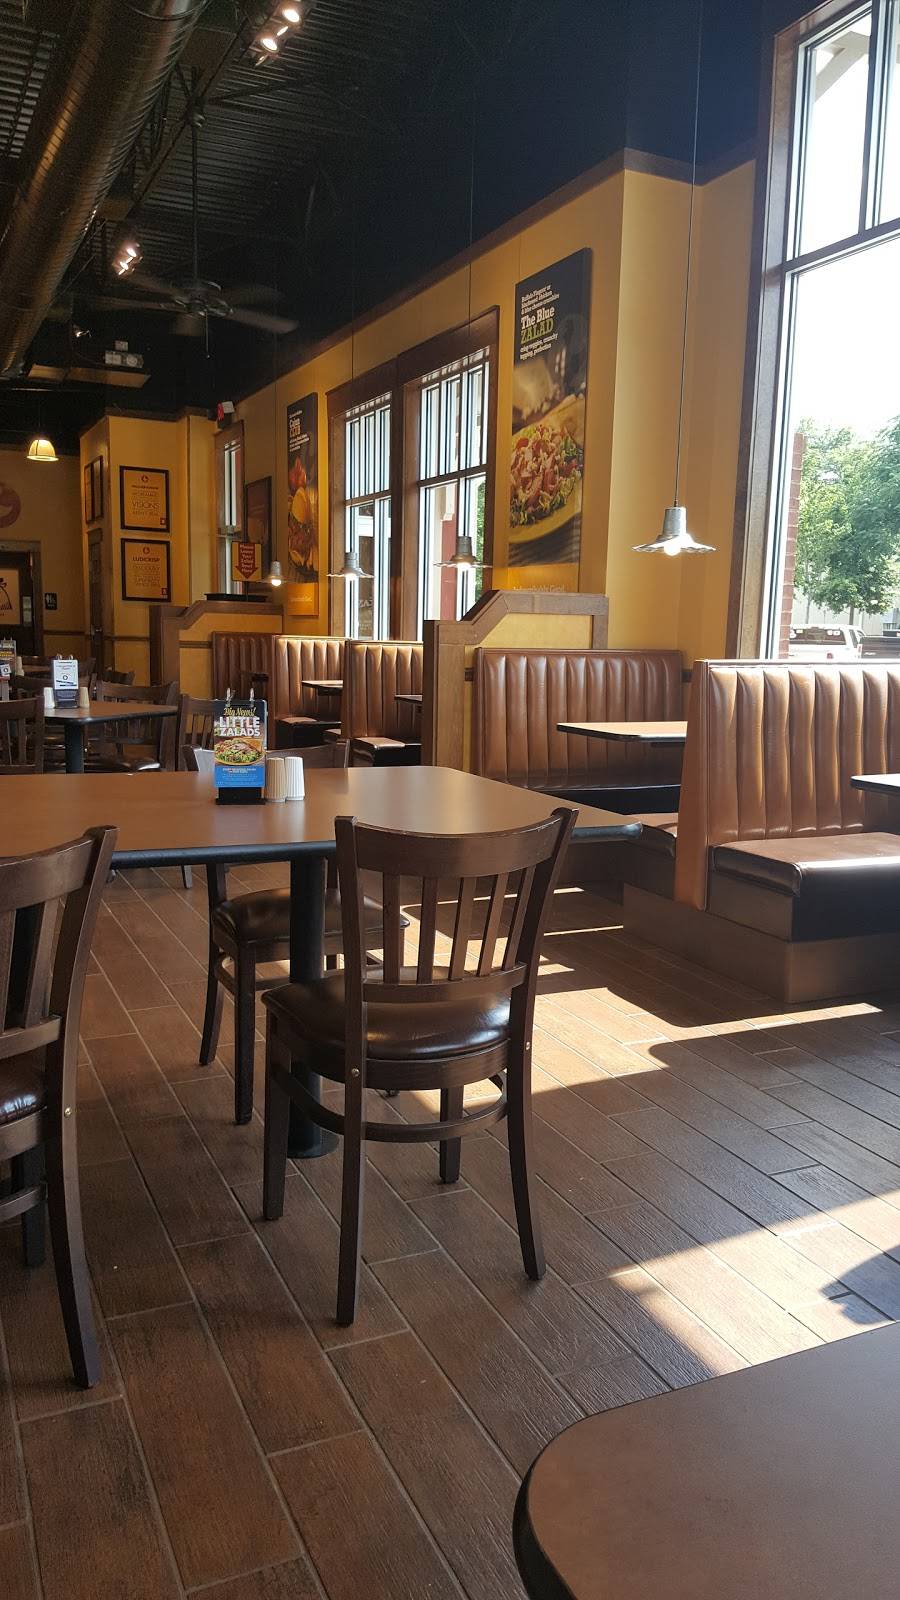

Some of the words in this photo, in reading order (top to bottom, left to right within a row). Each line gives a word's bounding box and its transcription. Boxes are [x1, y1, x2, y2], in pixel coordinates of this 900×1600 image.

[521, 315, 536, 330] The
[536, 306, 555, 322] Blue
[521, 318, 553, 344] ZALAD
[237, 706, 256, 716] News!
[219, 716, 260, 728] LITTLE
[219, 727, 261, 737] ZALADS
